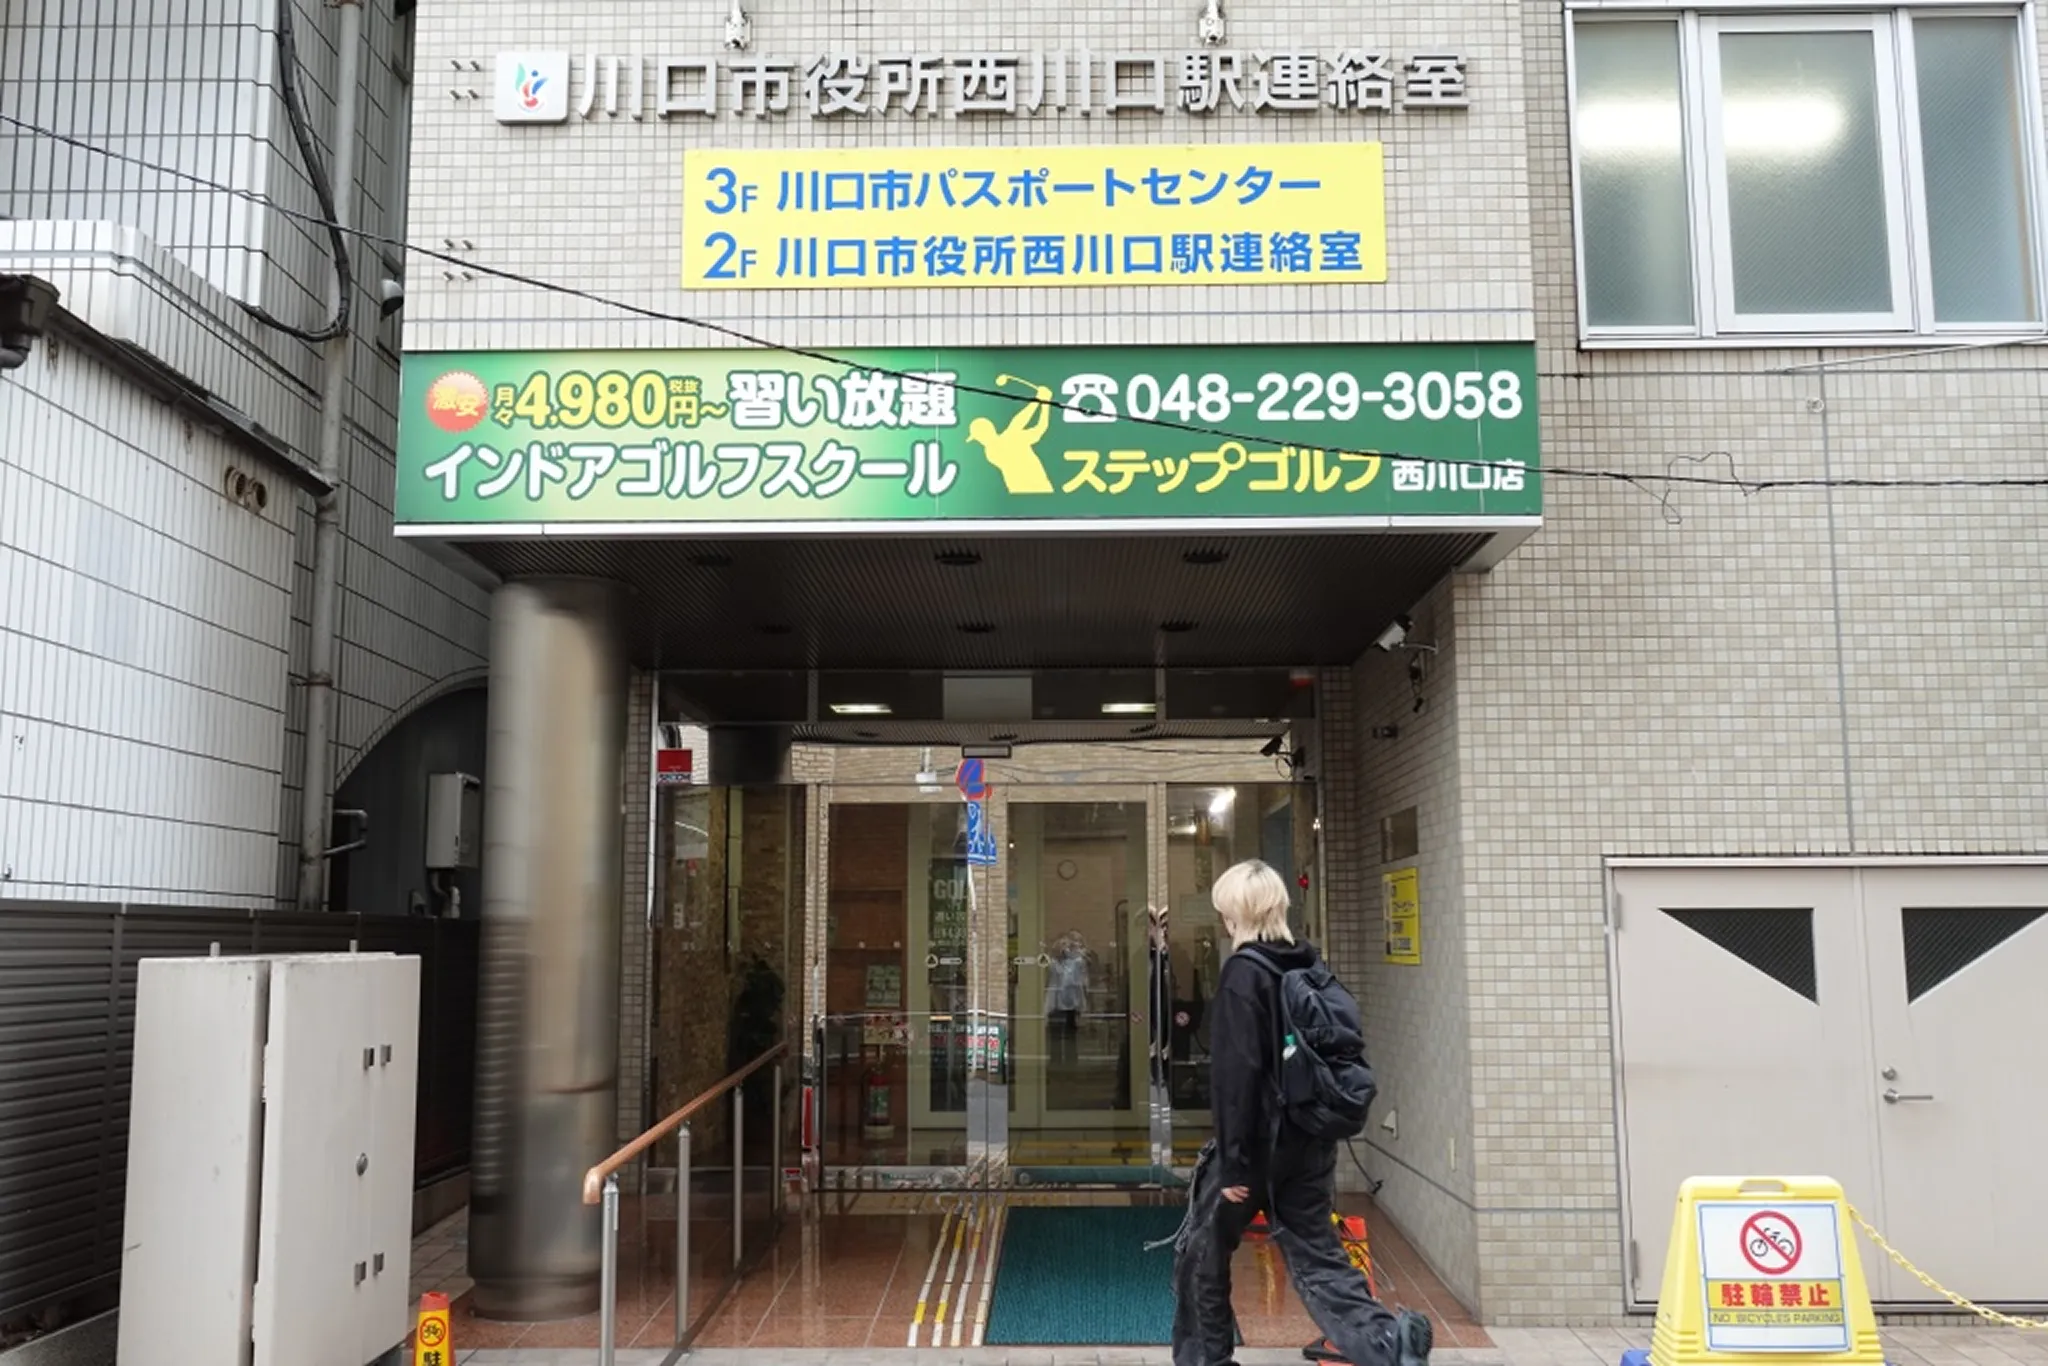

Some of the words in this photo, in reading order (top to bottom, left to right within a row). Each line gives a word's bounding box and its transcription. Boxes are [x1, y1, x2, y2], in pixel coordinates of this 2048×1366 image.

[577, 48, 1470, 119] 川口市役所西川口駅連絡室
[704, 167, 758, 213] 3F
[777, 166, 1321, 211] 川口市パスポートセンター
[703, 232, 758, 278] 2F
[776, 231, 1363, 277] 川口市役所西川口駅連絡室
[728, 371, 957, 427] 習い放題
[1126, 371, 1522, 422] 048-229-3058
[424, 440, 957, 498] インドアゴルフスクール
[1062, 442, 1381, 494] ステップゴルフ
[1392, 459, 1525, 491] 西川口店
[1713, 1313, 1730, 1323] NO
[1736, 1313, 1791, 1324] BICYCLES
[1793, 1313, 1841, 1323] PARKING
[1721, 1283, 1830, 1307] 駐輪禁止
